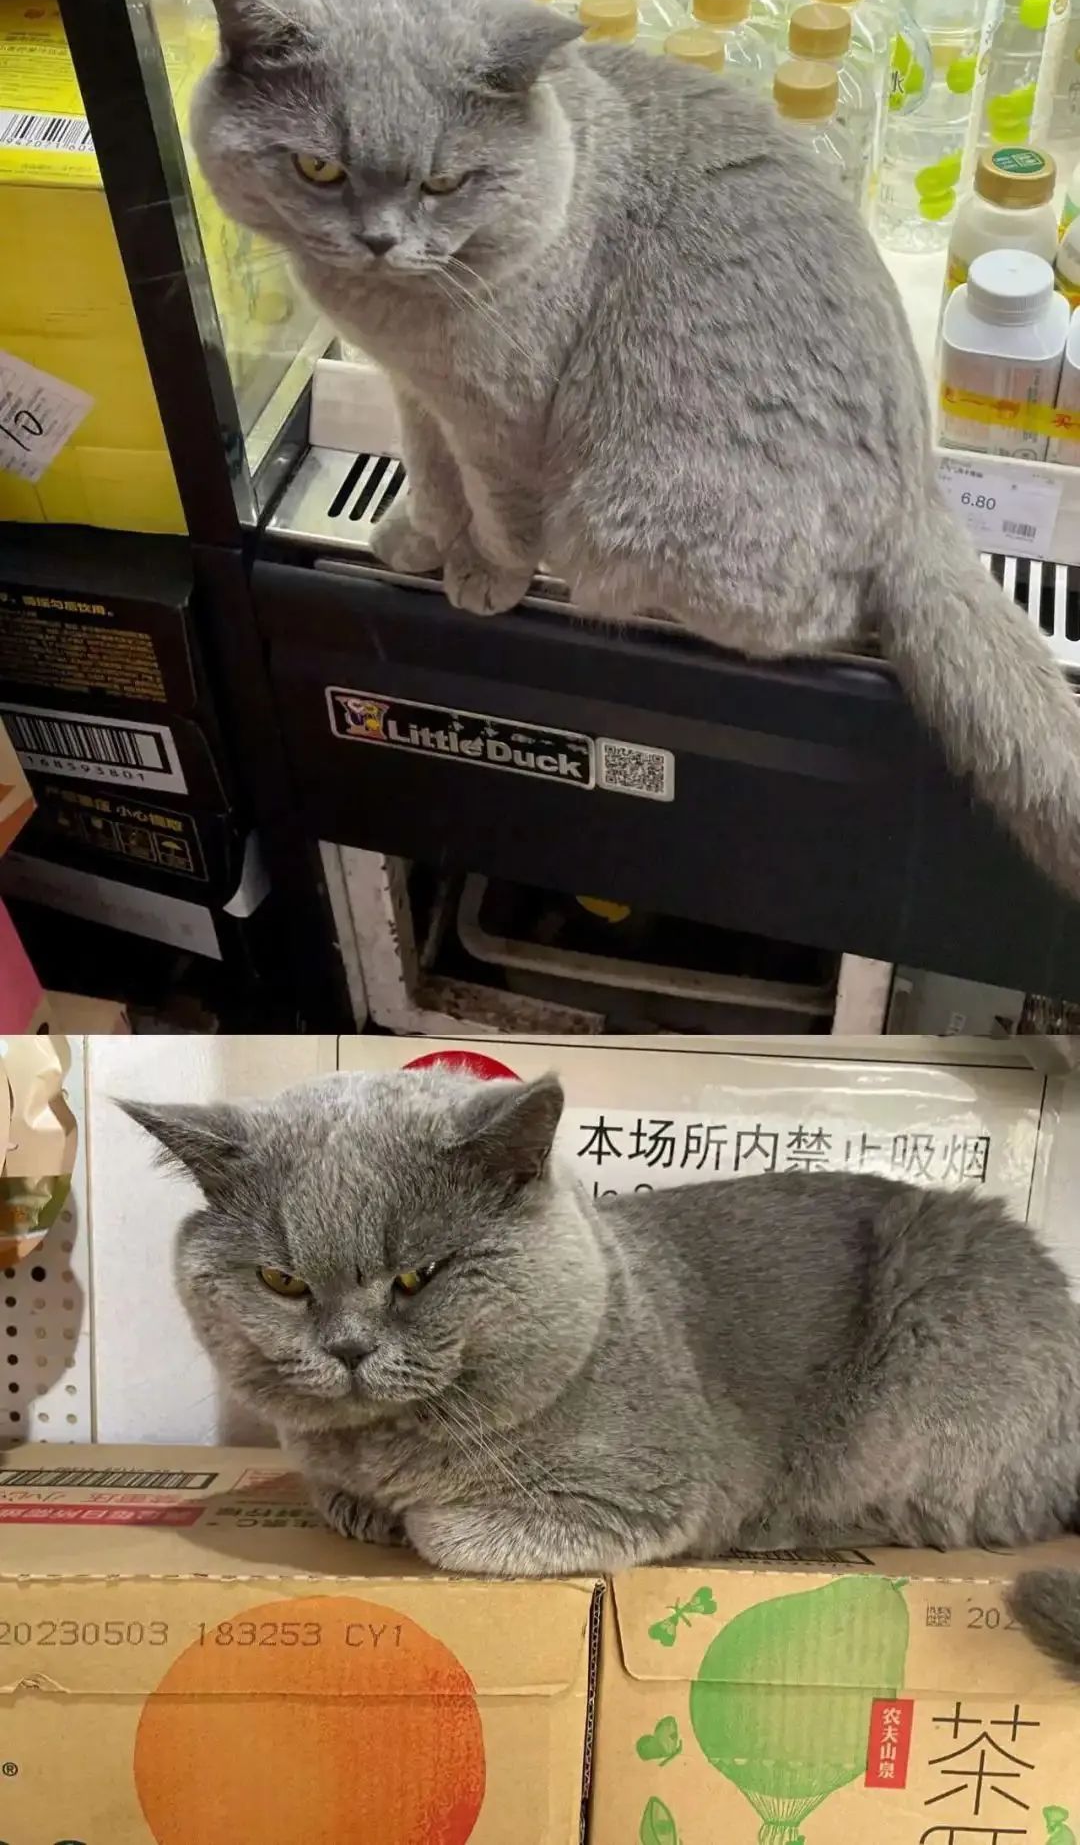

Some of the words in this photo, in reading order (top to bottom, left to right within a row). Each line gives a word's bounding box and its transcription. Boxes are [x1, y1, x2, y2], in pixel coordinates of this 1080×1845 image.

[961, 492, 997, 512] 6.80
[577, 1115, 991, 1184] 本场所内禁止吸烟
[0, 1621, 169, 1647] 20230503
[199, 1621, 322, 1647] 183253
[345, 1623, 403, 1648] CY1
[878, 1706, 902, 1780] 农夫山泉
